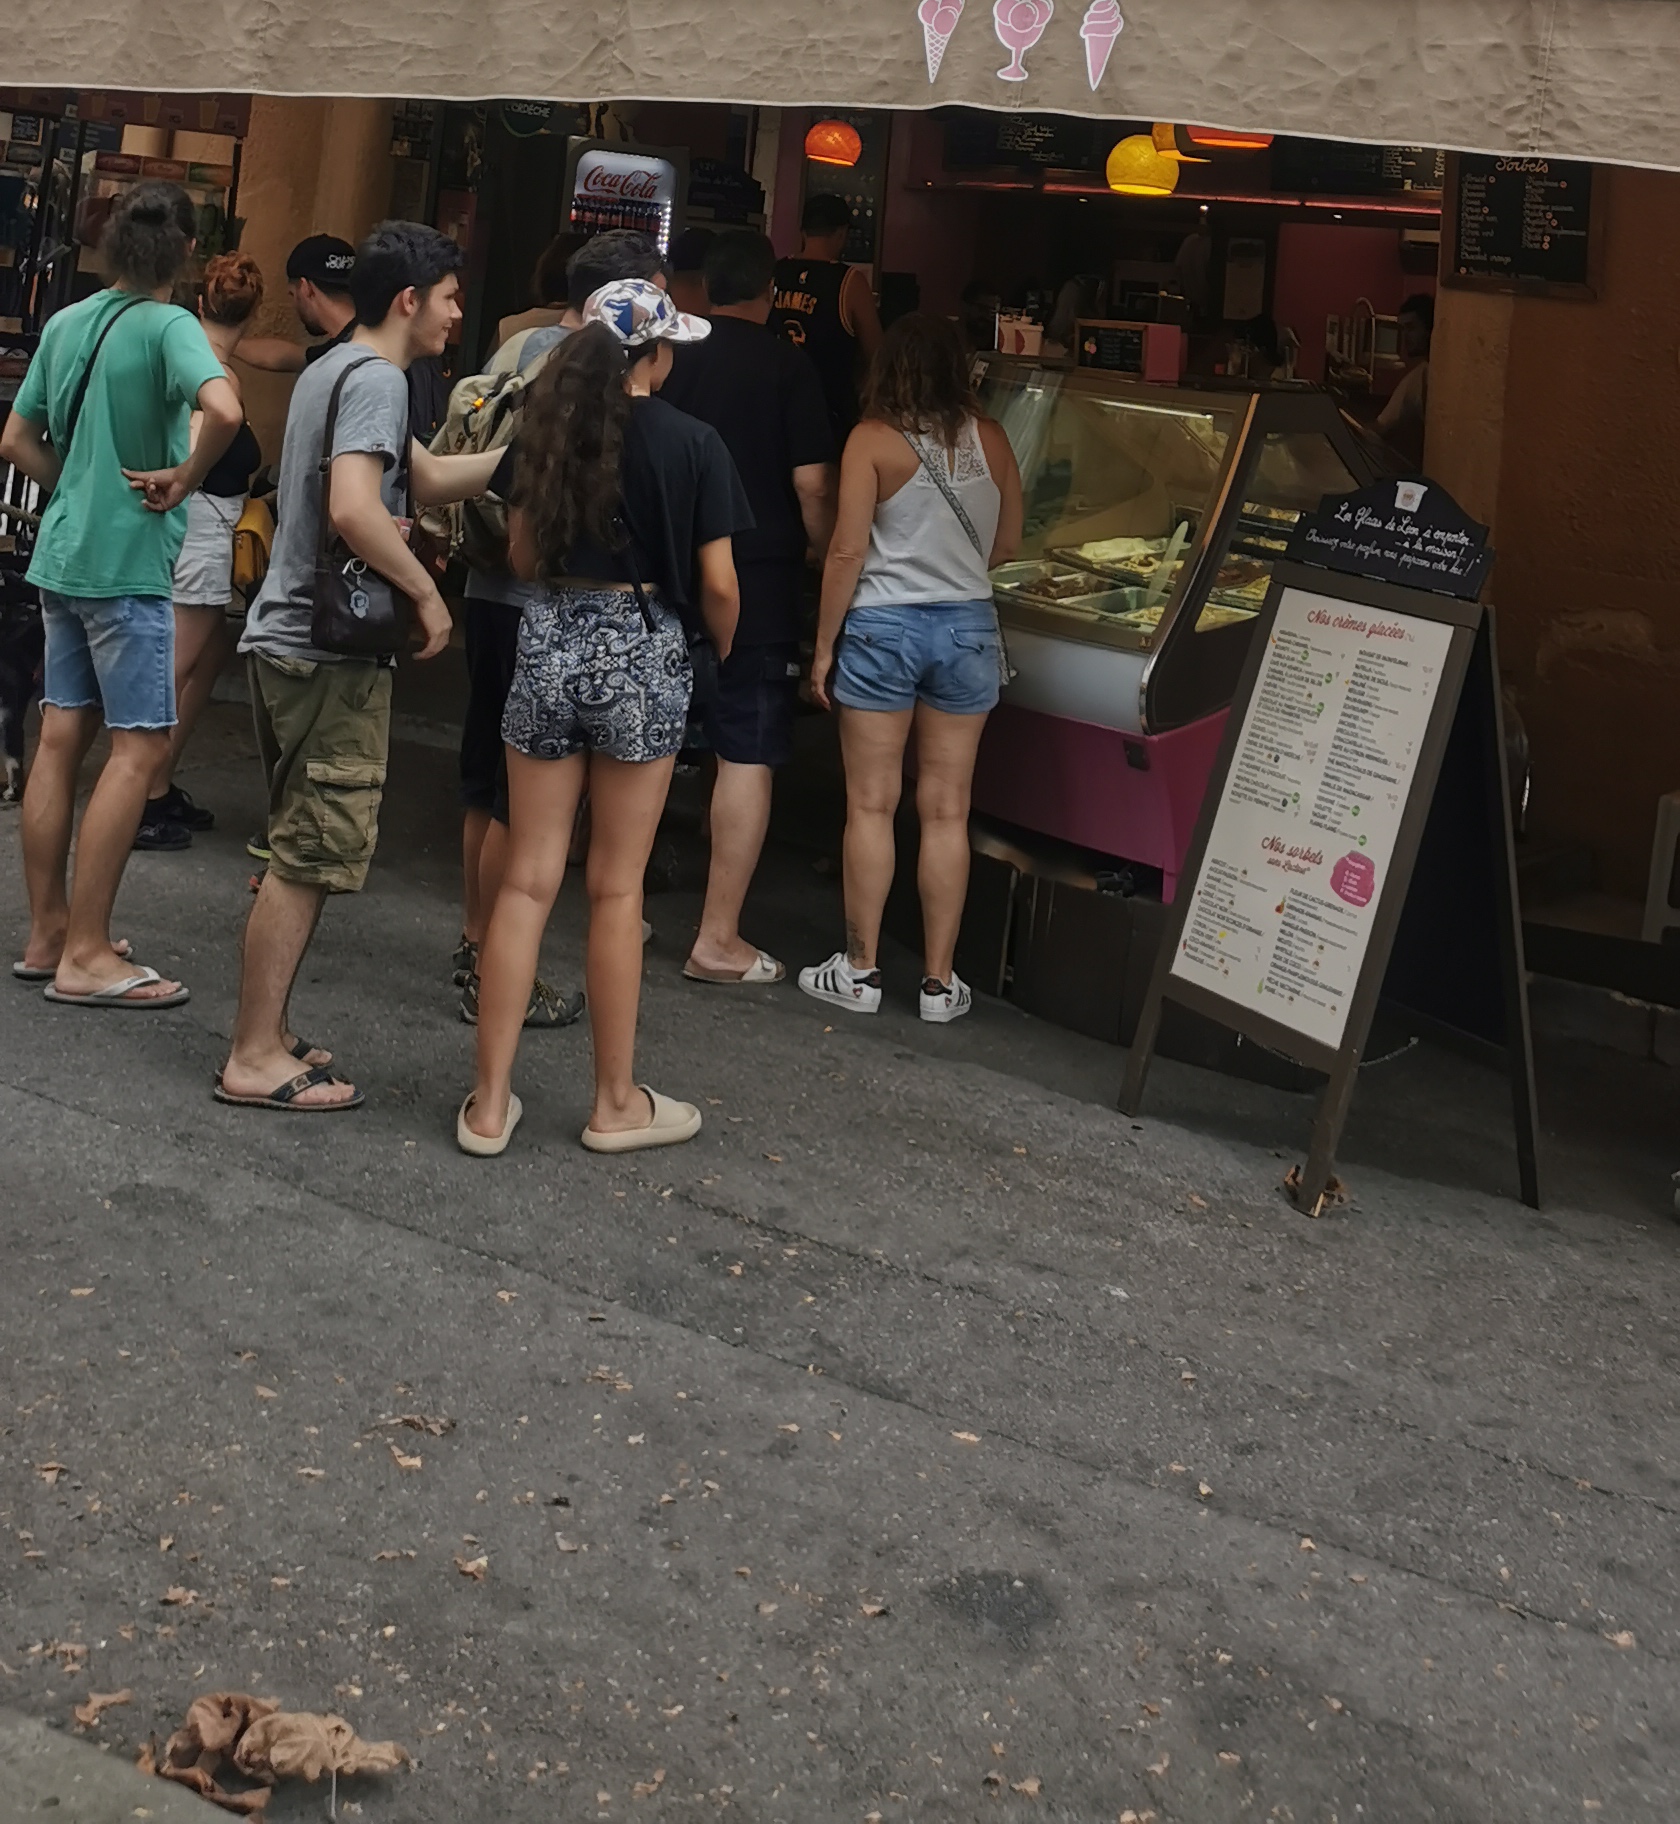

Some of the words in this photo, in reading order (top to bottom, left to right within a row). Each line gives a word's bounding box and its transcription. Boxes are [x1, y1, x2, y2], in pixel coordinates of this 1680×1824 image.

[583, 165, 663, 199] Coca-Cola
[775, 290, 817, 315] JAMES
[1334, 502, 1352, 523] Les
[1385, 516, 1396, 531] de
[1307, 609, 1331, 626] Nos
[1332, 613, 1367, 632] crèmes
[1366, 621, 1405, 640] glacées
[1261, 835, 1286, 854] Nos
[1286, 846, 1323, 865] sorbets
